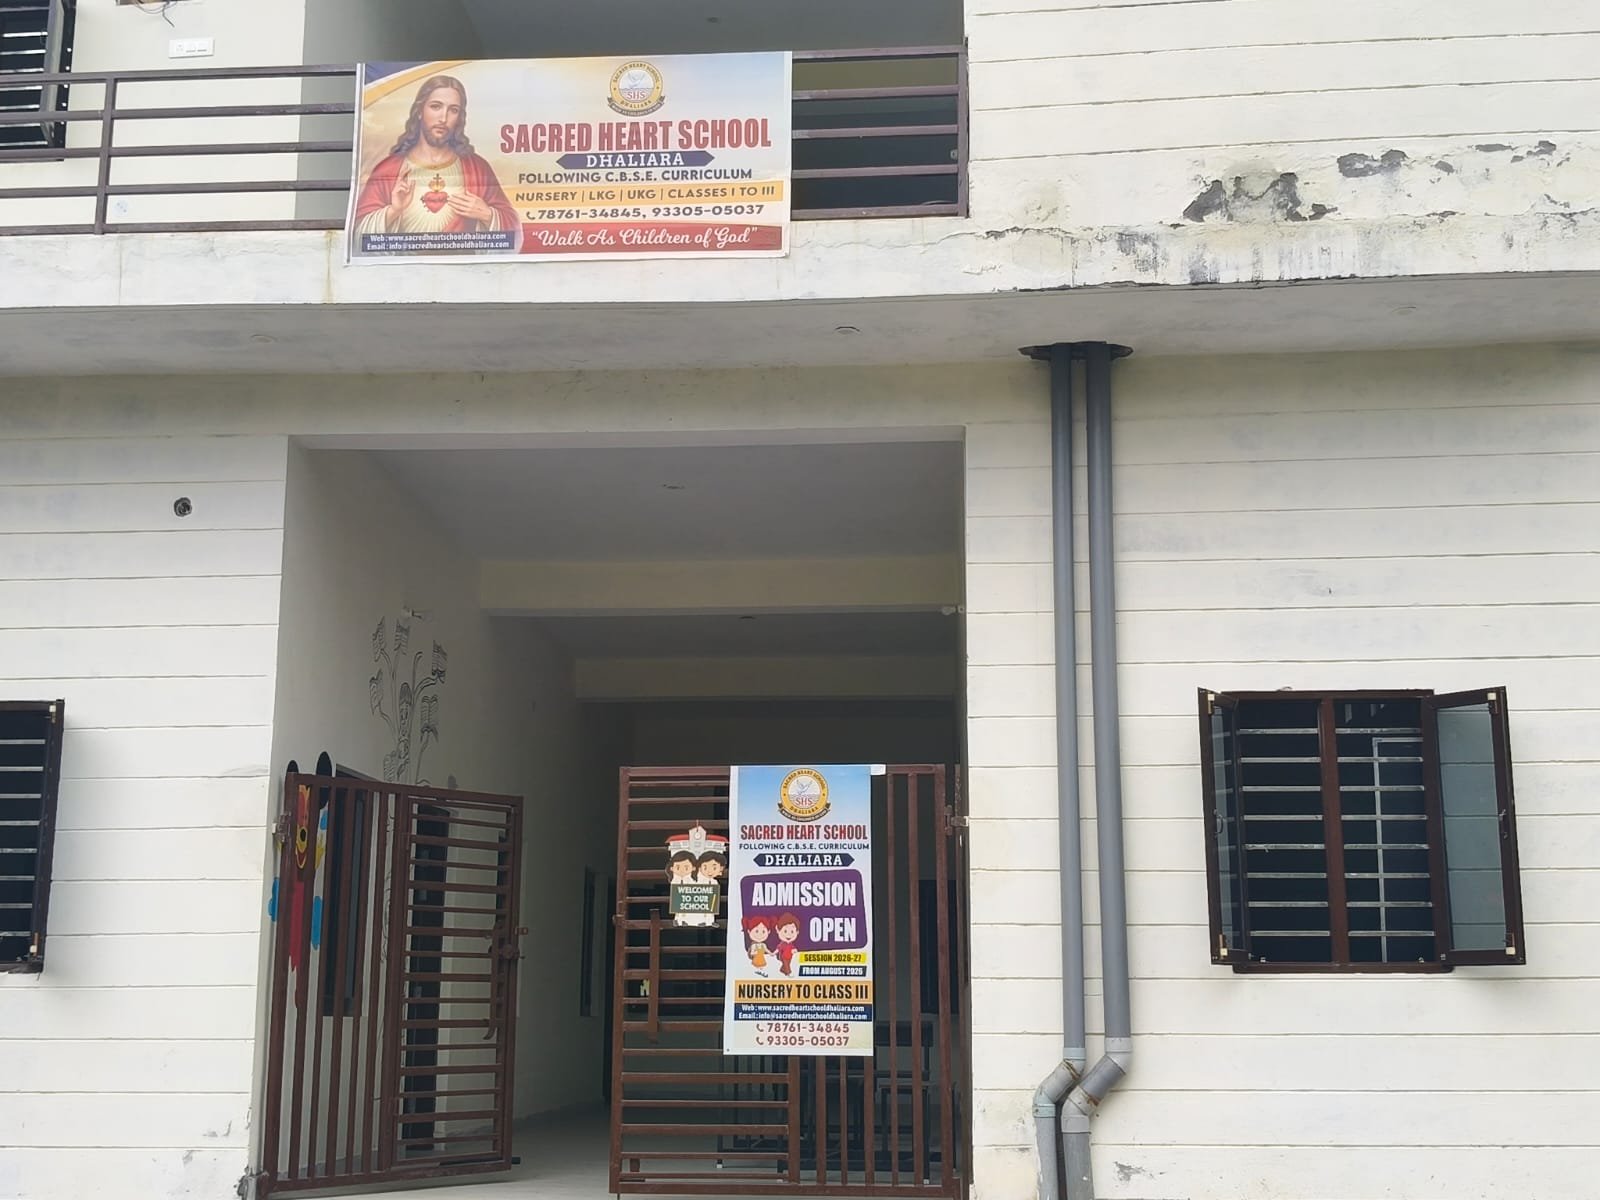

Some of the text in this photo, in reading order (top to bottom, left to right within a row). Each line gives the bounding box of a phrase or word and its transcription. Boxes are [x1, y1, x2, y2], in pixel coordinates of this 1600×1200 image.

[627, 91, 646, 100] SHS
[500, 118, 772, 153] SACRED HEART SCHOOL
[586, 153, 685, 168] DHALIARA
[518, 168, 752, 184] FOLLOWING C.B.S.E. CURRICULUM
[515, 185, 775, 201] NURSERY LKG UKG CLASSES I TO III
[537, 204, 765, 219] 78761-34845, 93305-05037
[586, 228, 617, 246] As
[619, 227, 692, 246] Children
[694, 226, 713, 248] of
[795, 797, 813, 806] SHS
[740, 824, 868, 840] SACRED HEART SCHOOL
[787, 843, 817, 851] C.B.S.E.
[764, 854, 843, 866] DHALIARA
[677, 886, 714, 894] WELCOME
[751, 882, 857, 907] ADMISSION
[681, 895, 709, 903] TO OUR
[680, 903, 710, 911] SCHOOL
[809, 916, 856, 943] OPEN
[804, 953, 862, 962] SESSION 2026-27
[802, 966, 820, 975] FROM
[820, 966, 846, 976] AUGUST
[738, 984, 868, 1000] NURSERY TO CLASS III
[767, 1022, 850, 1034] 78761-34845
[767, 1035, 850, 1047] 93305-05037
